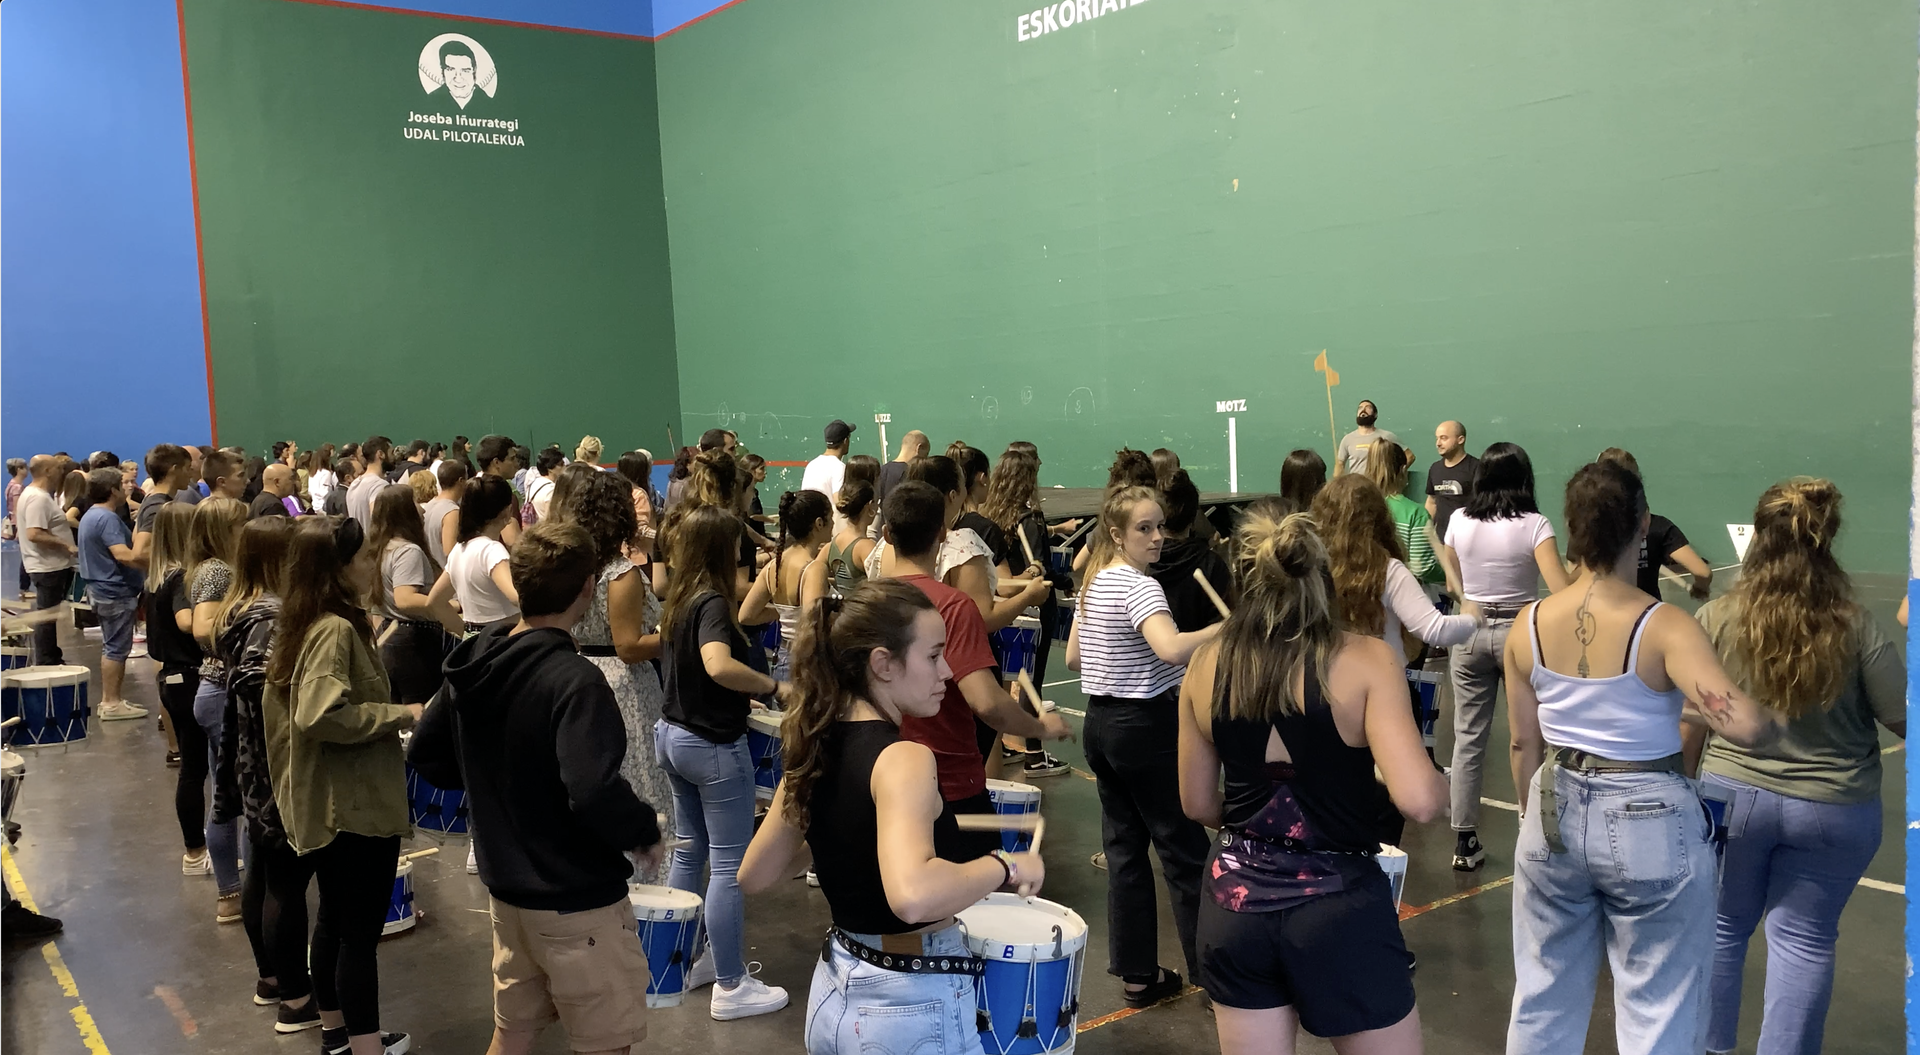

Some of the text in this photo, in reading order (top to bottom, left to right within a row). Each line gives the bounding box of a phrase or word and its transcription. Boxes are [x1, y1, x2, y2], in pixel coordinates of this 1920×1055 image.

[408, 111, 519, 132] Joseba Iñurrategi
[404, 128, 525, 147] UDAL PILOTALEKUA
[1216, 399, 1247, 412] MOTZ
[1738, 526, 1745, 536] 2
[664, 910, 674, 920] B
[1003, 945, 1014, 958] B
